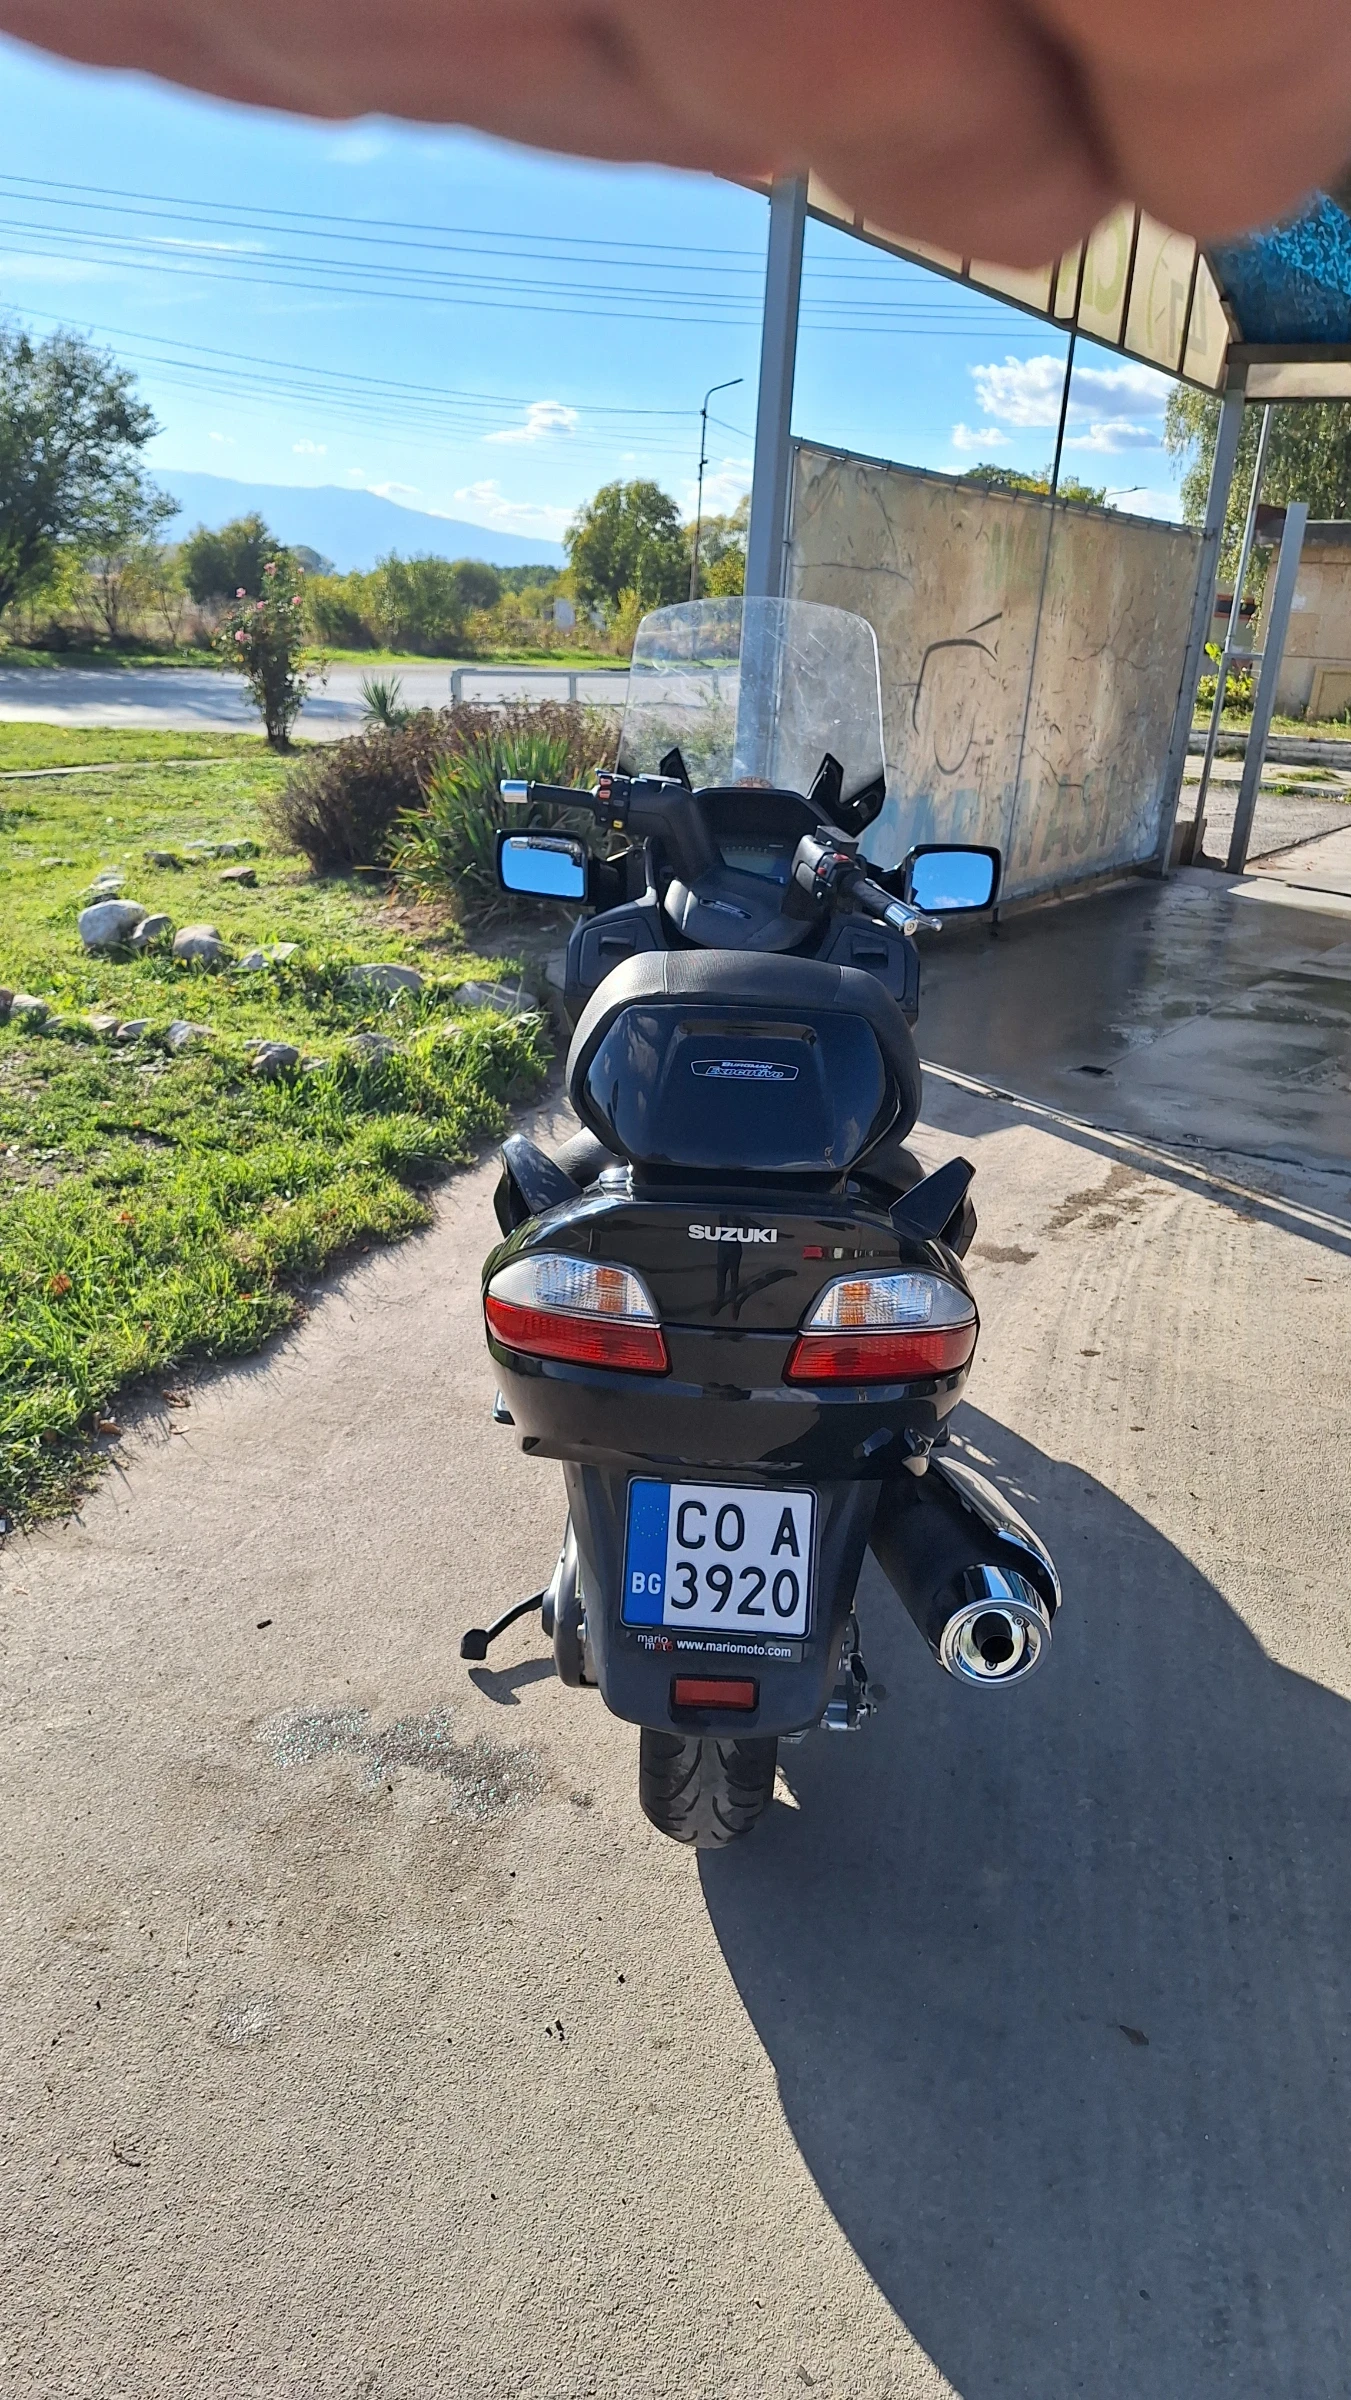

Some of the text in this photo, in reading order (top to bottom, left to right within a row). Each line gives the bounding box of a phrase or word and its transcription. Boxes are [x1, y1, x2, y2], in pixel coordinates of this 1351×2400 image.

[705, 1065, 785, 1079] Executive
[687, 1224, 778, 1243] SUZUKI
[676, 1500, 801, 1558] CO A
[631, 1571, 662, 1595] BG
[670, 1561, 800, 1618] 3920
[637, 1633, 669, 1644] mario
[644, 1640, 674, 1653] moto
[676, 1639, 792, 1658] www.mariomoto.com
